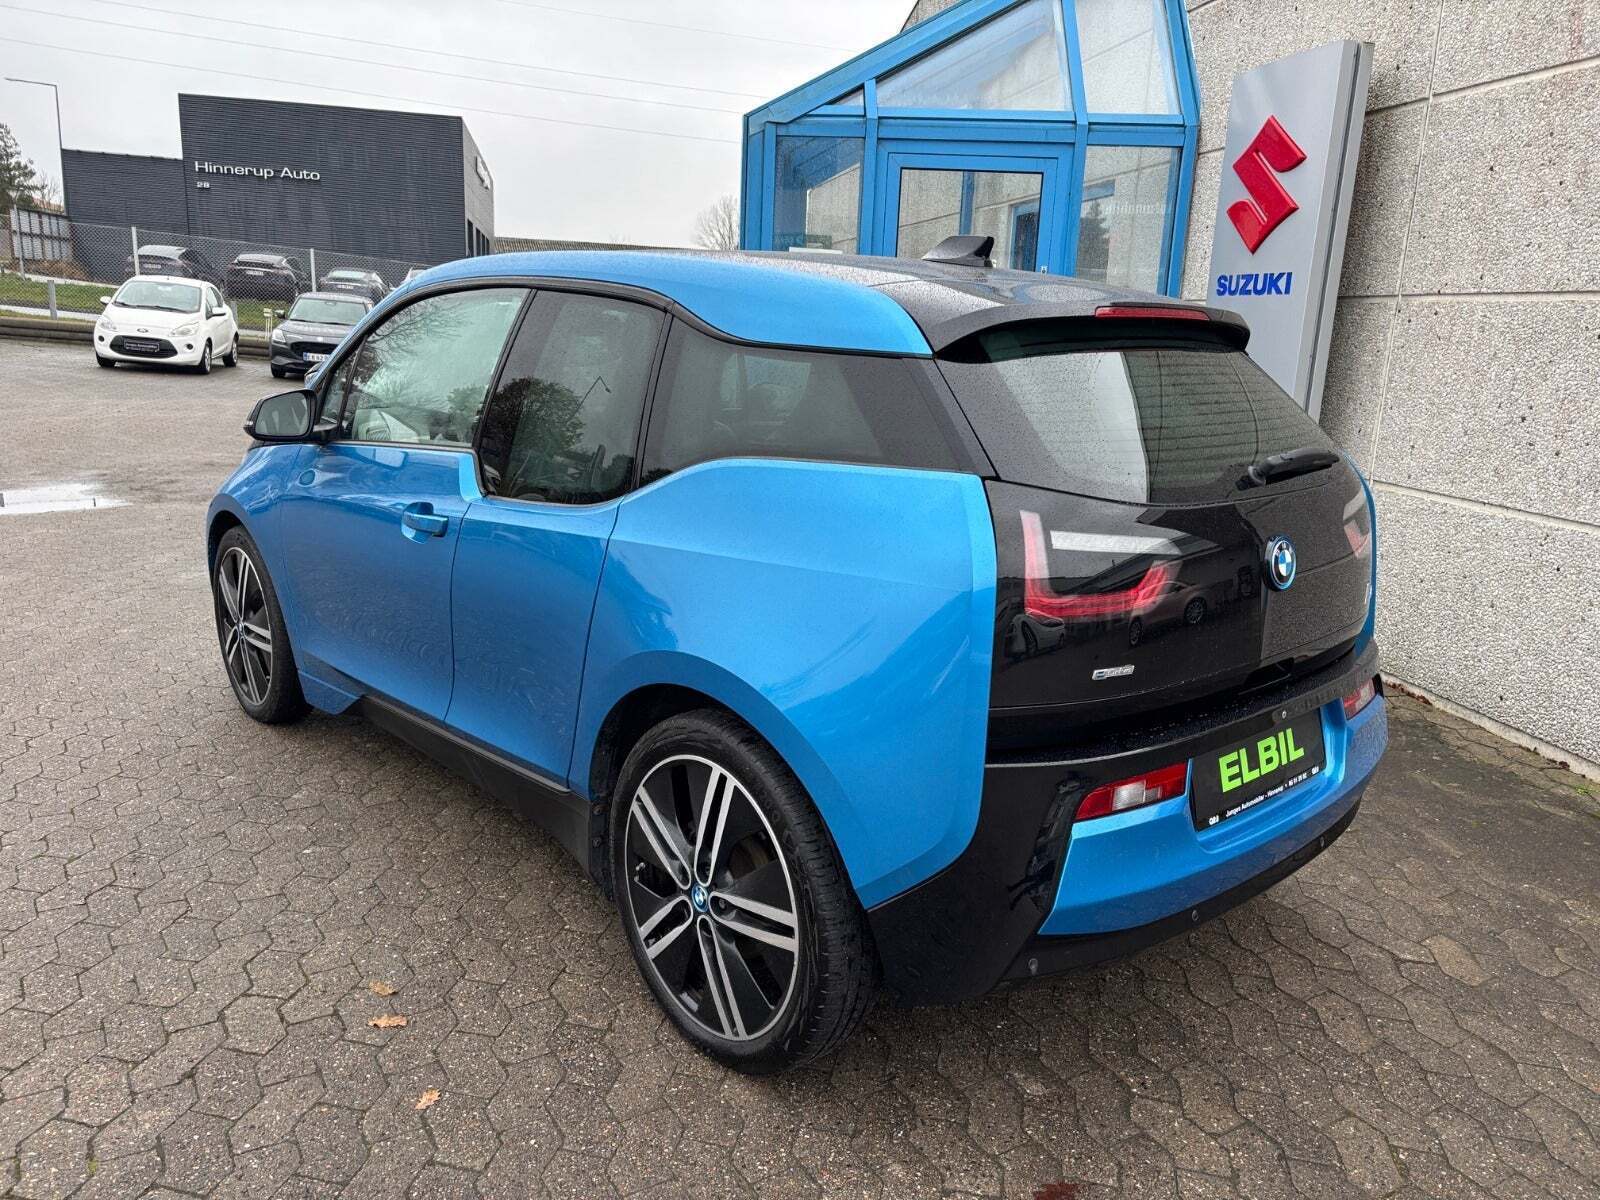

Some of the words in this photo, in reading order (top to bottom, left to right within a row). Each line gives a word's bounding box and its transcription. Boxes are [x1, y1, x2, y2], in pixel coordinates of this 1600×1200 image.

[195, 161, 274, 179] Hinnerup
[280, 167, 321, 181] Auto
[1216, 272, 1292, 296] SUZUKI
[1219, 728, 1304, 792] ELBIL
